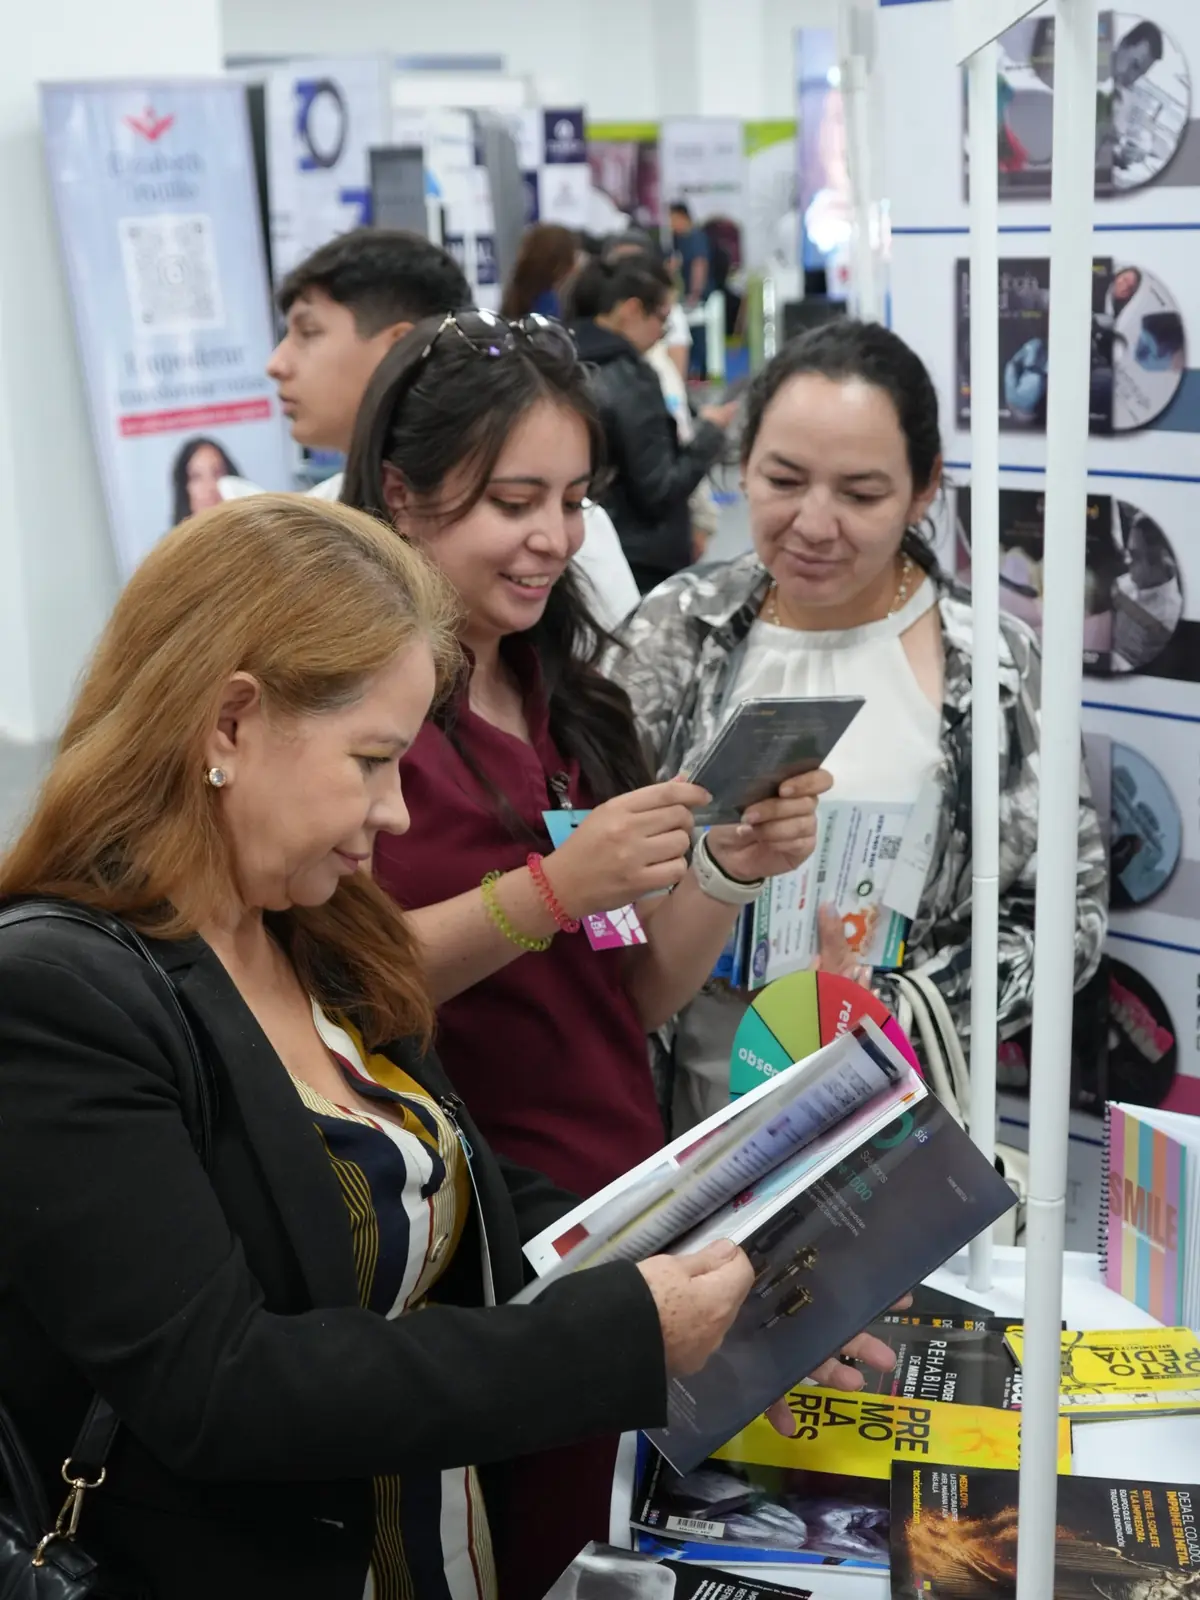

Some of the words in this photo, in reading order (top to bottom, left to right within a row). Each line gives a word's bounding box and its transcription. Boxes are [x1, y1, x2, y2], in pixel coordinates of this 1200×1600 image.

[835, 999, 852, 1041] rev
[1108, 1171, 1178, 1252] SMILE
[910, 1356, 921, 1365] DE
[920, 1340, 947, 1402] REHABILI
[906, 1365, 920, 1385] MIRAR
[904, 1385, 915, 1393] EL
[942, 1380, 956, 1401] PODER
[788, 1393, 822, 1440] RES
[823, 1397, 858, 1427] LA
[858, 1401, 894, 1441] MO
[894, 1406, 931, 1454] PRE
[912, 1470, 922, 1524] tecnicadental.com
[950, 1480, 958, 1508] ESTRUCTURA
[1120, 1489, 1130, 1511] EQUIPOS
[1130, 1495, 1140, 1504] LA
[1143, 1490, 1154, 1511] ENTRE
[1178, 1492, 1192, 1513] DEJA
[1146, 1512, 1155, 1520] EL
[1166, 1491, 1183, 1527] IMPRIME
[1182, 1514, 1194, 1525] EL
[1132, 1504, 1145, 1542] IMPRESORA:
[1147, 1520, 1160, 1548] SOPLETE
[1172, 1527, 1185, 1539] EN
[1175, 1539, 1190, 1566] METAL
